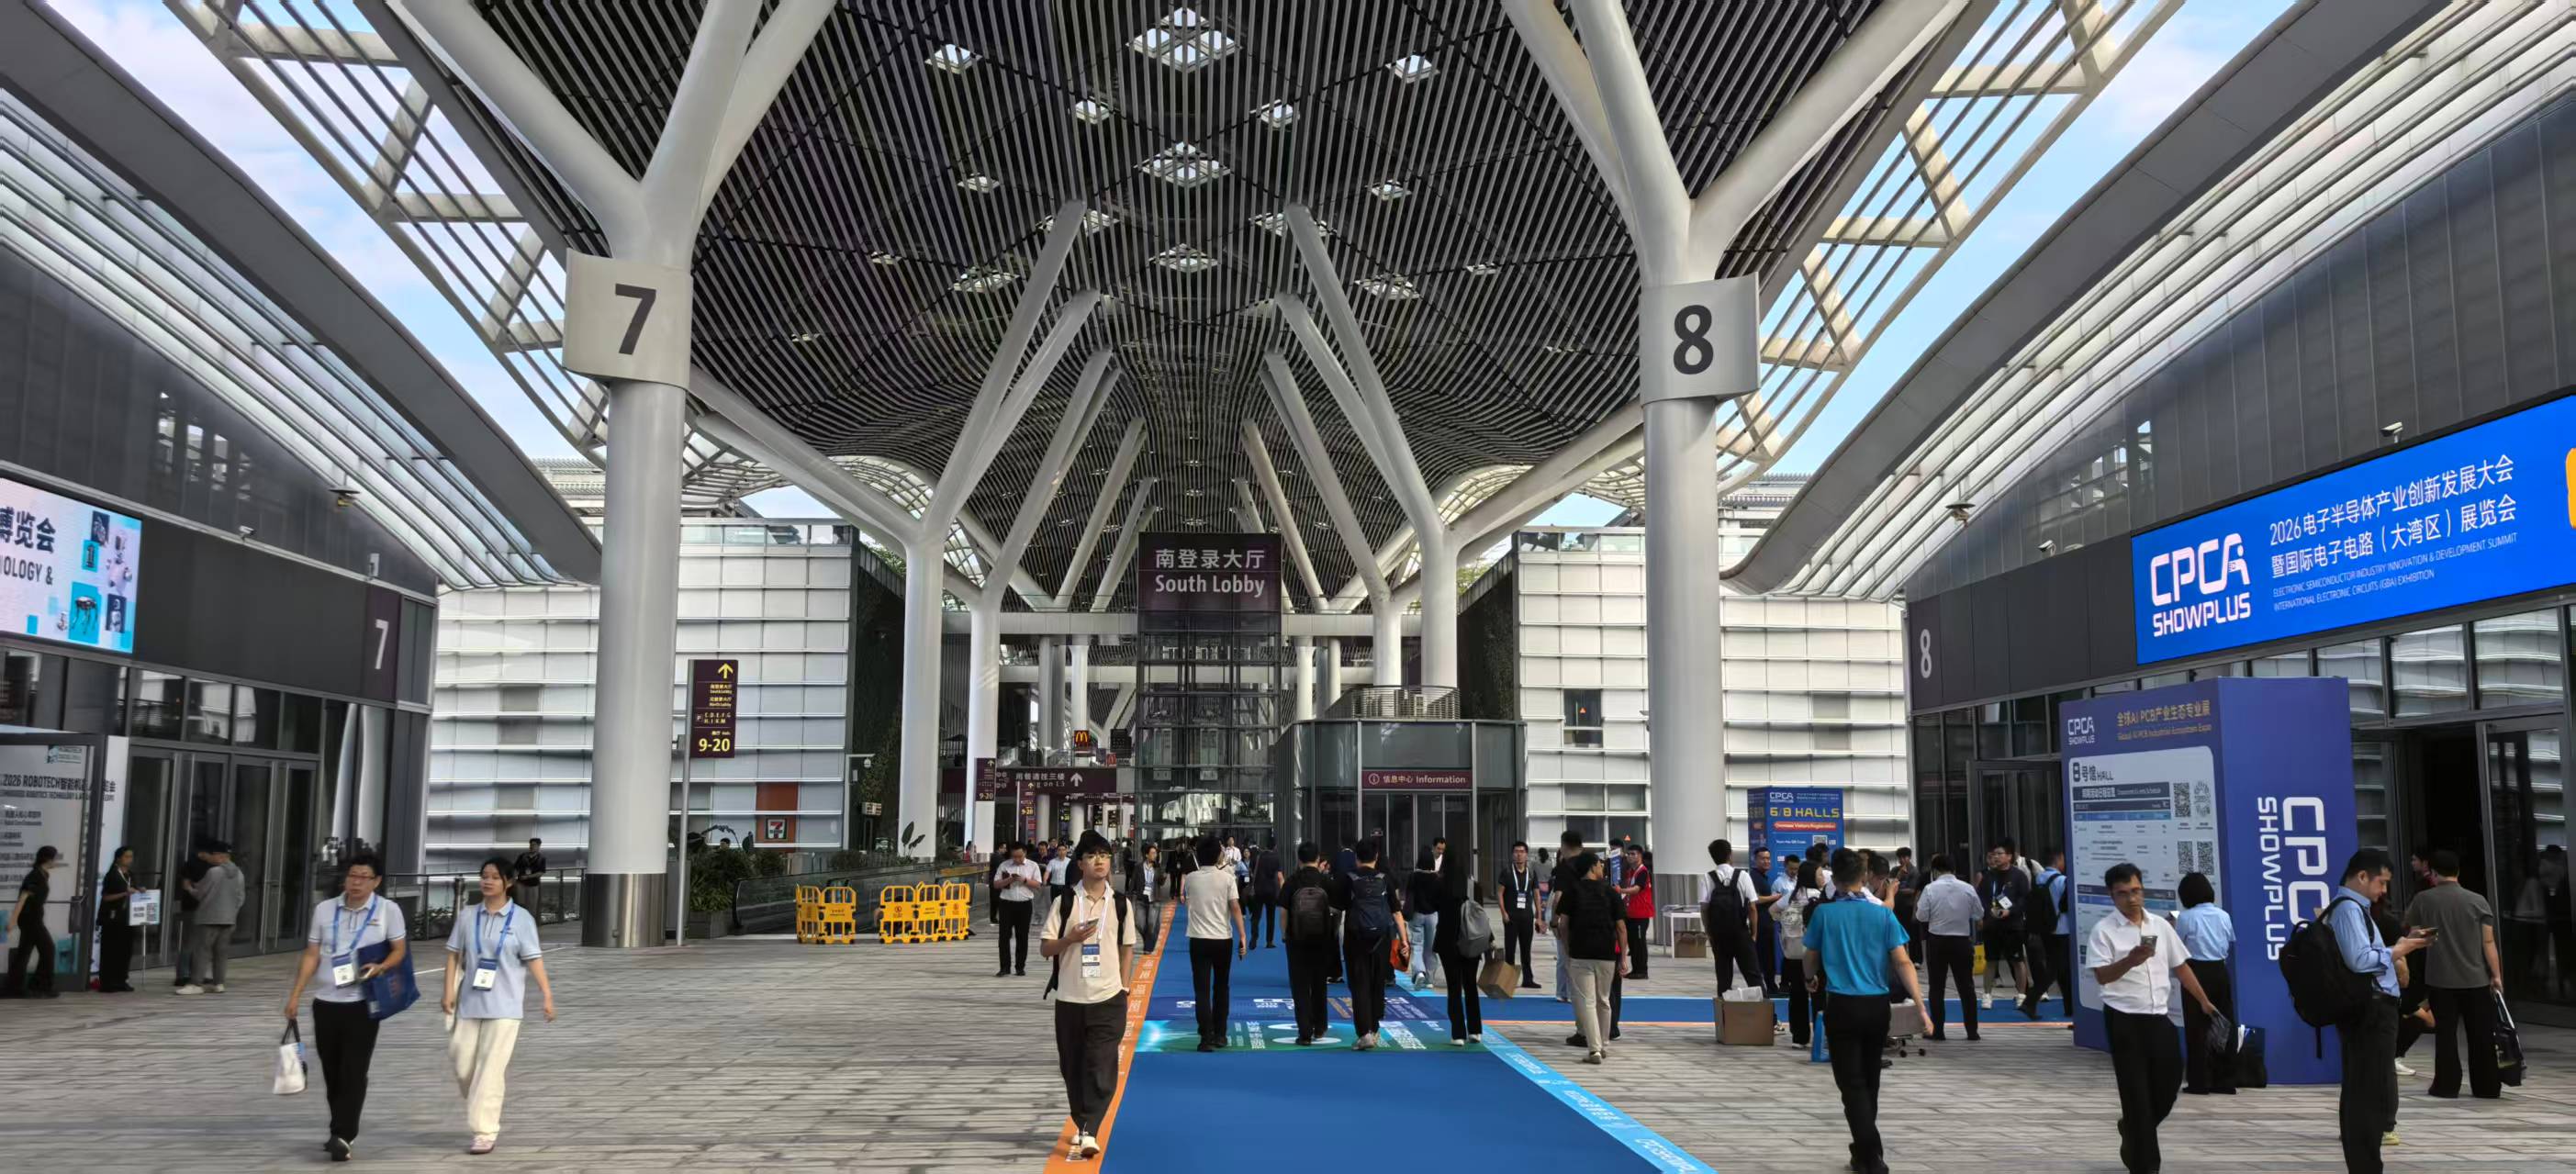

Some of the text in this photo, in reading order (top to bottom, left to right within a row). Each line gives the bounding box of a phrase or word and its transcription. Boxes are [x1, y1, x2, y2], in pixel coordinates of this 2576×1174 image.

[615, 283, 657, 355] 7
[1674, 304, 1714, 375] 8
[1155, 548, 1265, 569] 南登录大厅
[2150, 532, 2251, 607] CPCA
[1155, 574, 1265, 598] South Lobby
[2153, 591, 2251, 637] SHOWPLUS
[375, 619, 389, 669] 7
[1920, 629, 1932, 678] 8
[699, 738, 731, 752] 9-20
[2067, 716, 2095, 735] CPCA
[1416, 774, 1466, 784] Information
[1795, 808, 1840, 818] HALLS
[2257, 797, 2286, 961] SHOWPLUS
[2282, 797, 2331, 928] CPC
